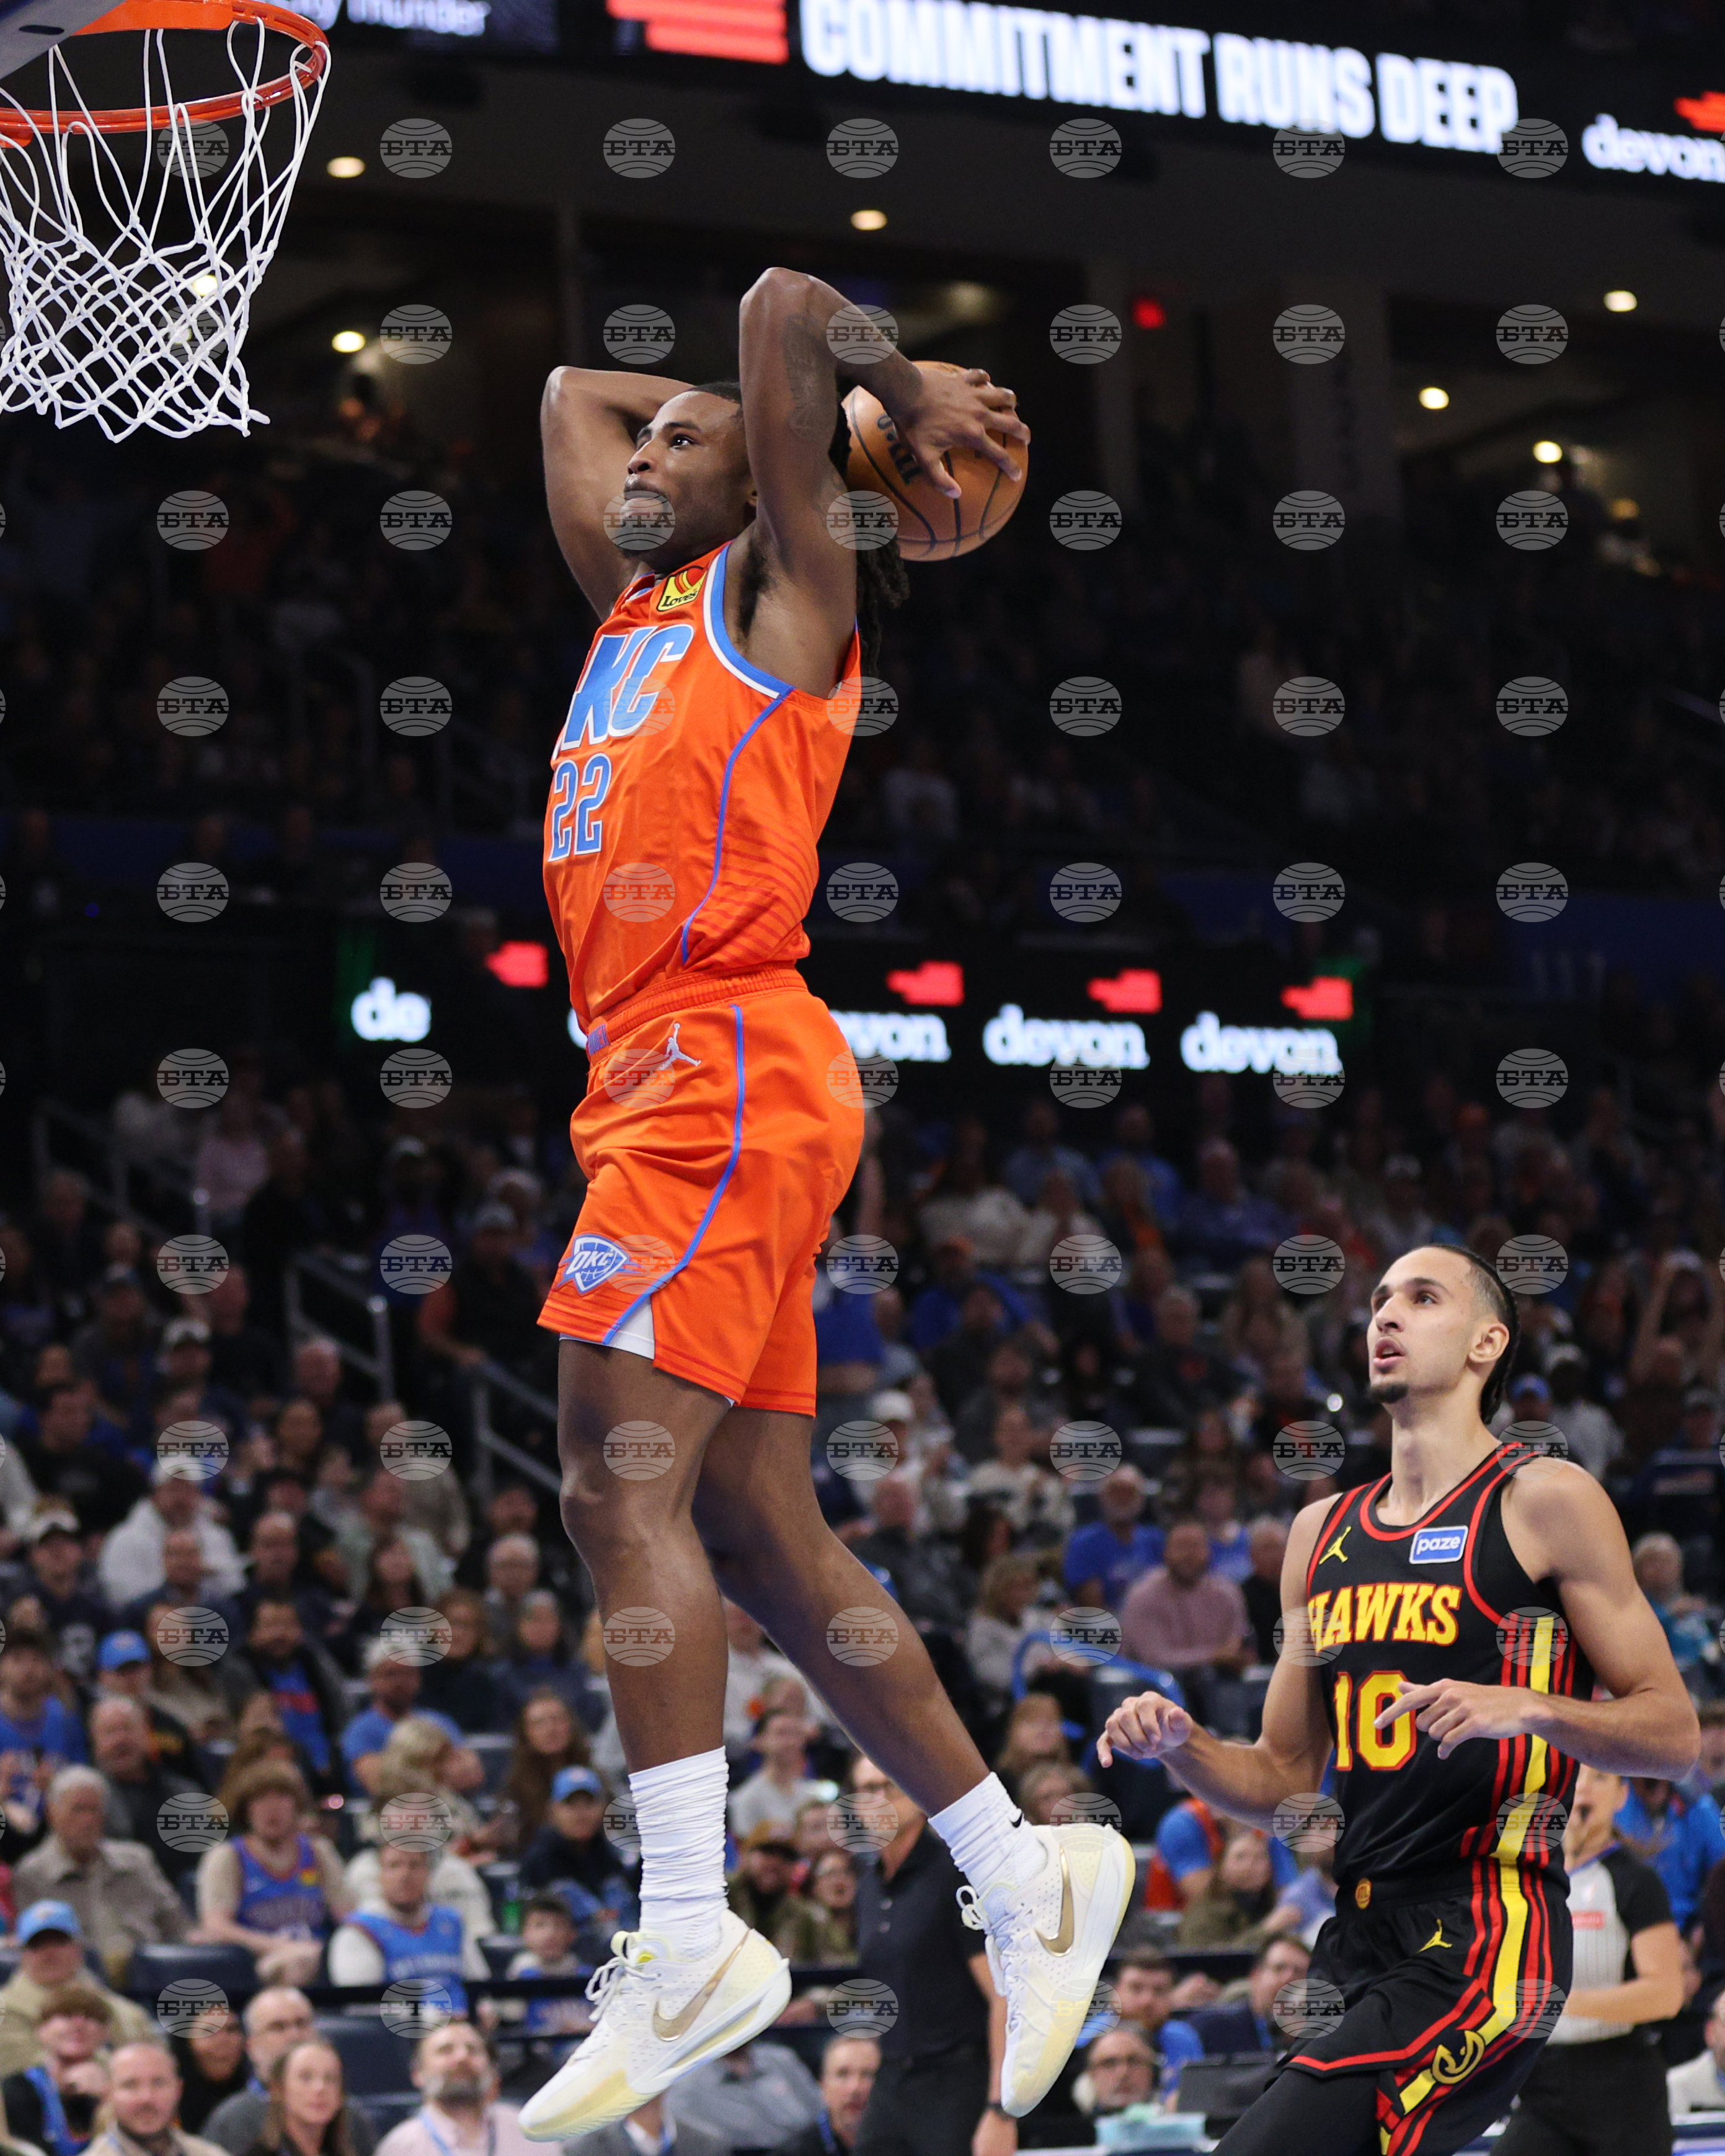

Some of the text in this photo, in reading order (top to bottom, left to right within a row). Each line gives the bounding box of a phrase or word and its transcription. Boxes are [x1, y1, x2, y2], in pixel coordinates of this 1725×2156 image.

[799, 0, 1519, 154] COMMITMENT RUNS DEEP
[1582, 114, 1725, 183] devon
[554, 624, 695, 758] KC
[548, 753, 612, 862] 22
[828, 1010, 951, 1062] von
[983, 1004, 1150, 1070] devon
[1181, 1011, 1343, 1076] devon
[565, 1251, 614, 1275] OKC
[1416, 1536, 1461, 1555] paze
[1308, 1582, 1463, 1656] HAWKS
[1334, 1670, 1417, 1772] 10
